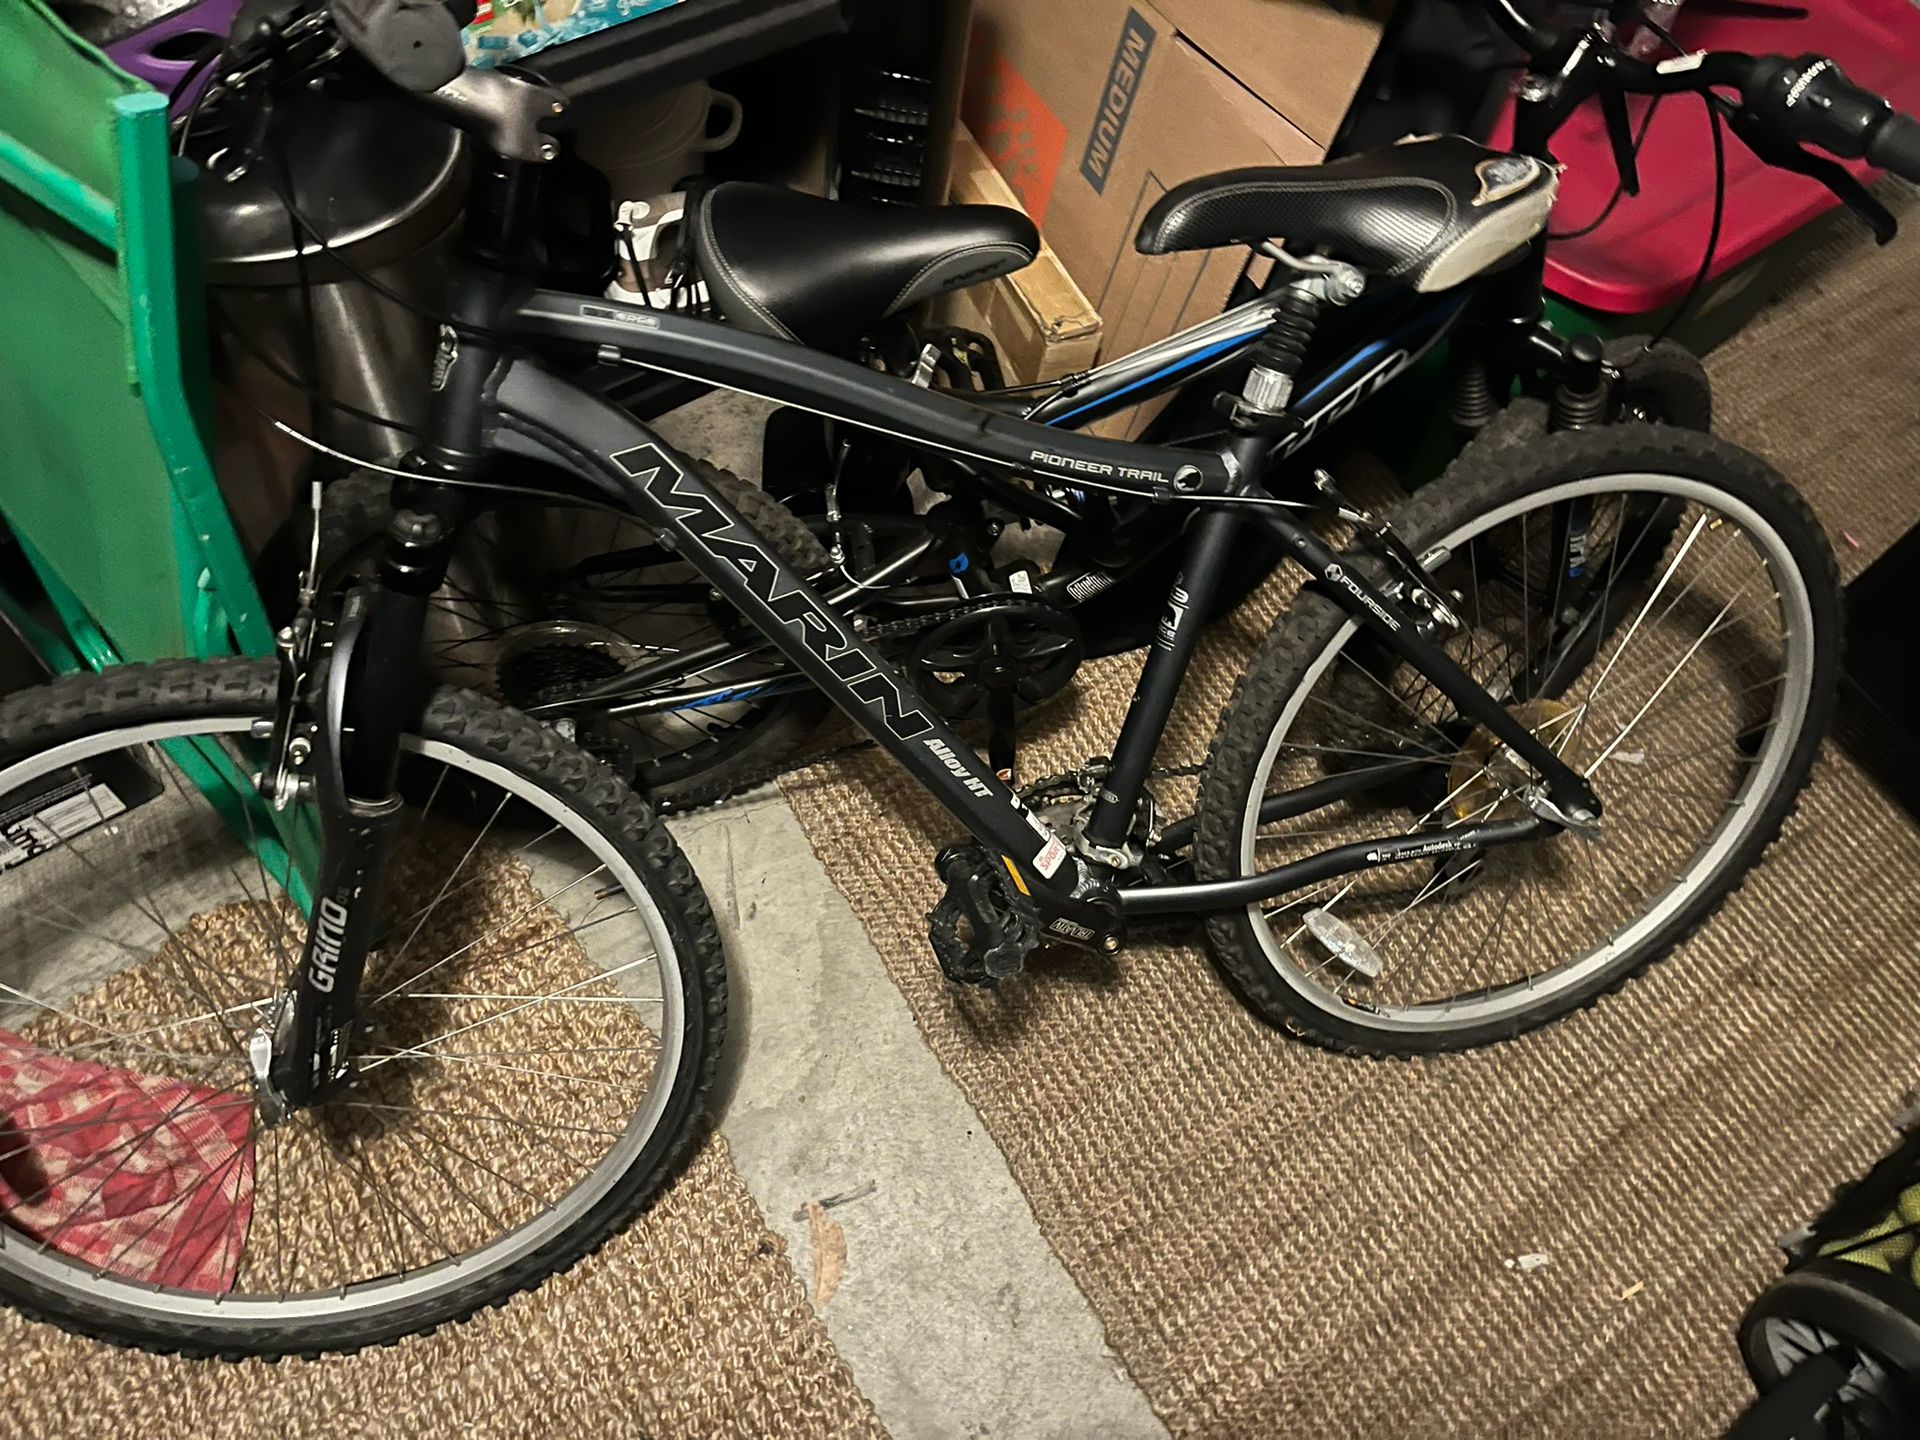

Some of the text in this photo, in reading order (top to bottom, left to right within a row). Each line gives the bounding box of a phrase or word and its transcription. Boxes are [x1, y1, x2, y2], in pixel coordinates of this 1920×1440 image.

[1087, 27, 1147, 178] MEDIUM
[1030, 450, 1169, 484] PIONEER TRAIL
[609, 442, 935, 741] MARIN
[1340, 575, 1401, 632] FOURSIDE
[922, 738, 994, 798] Alloy HT
